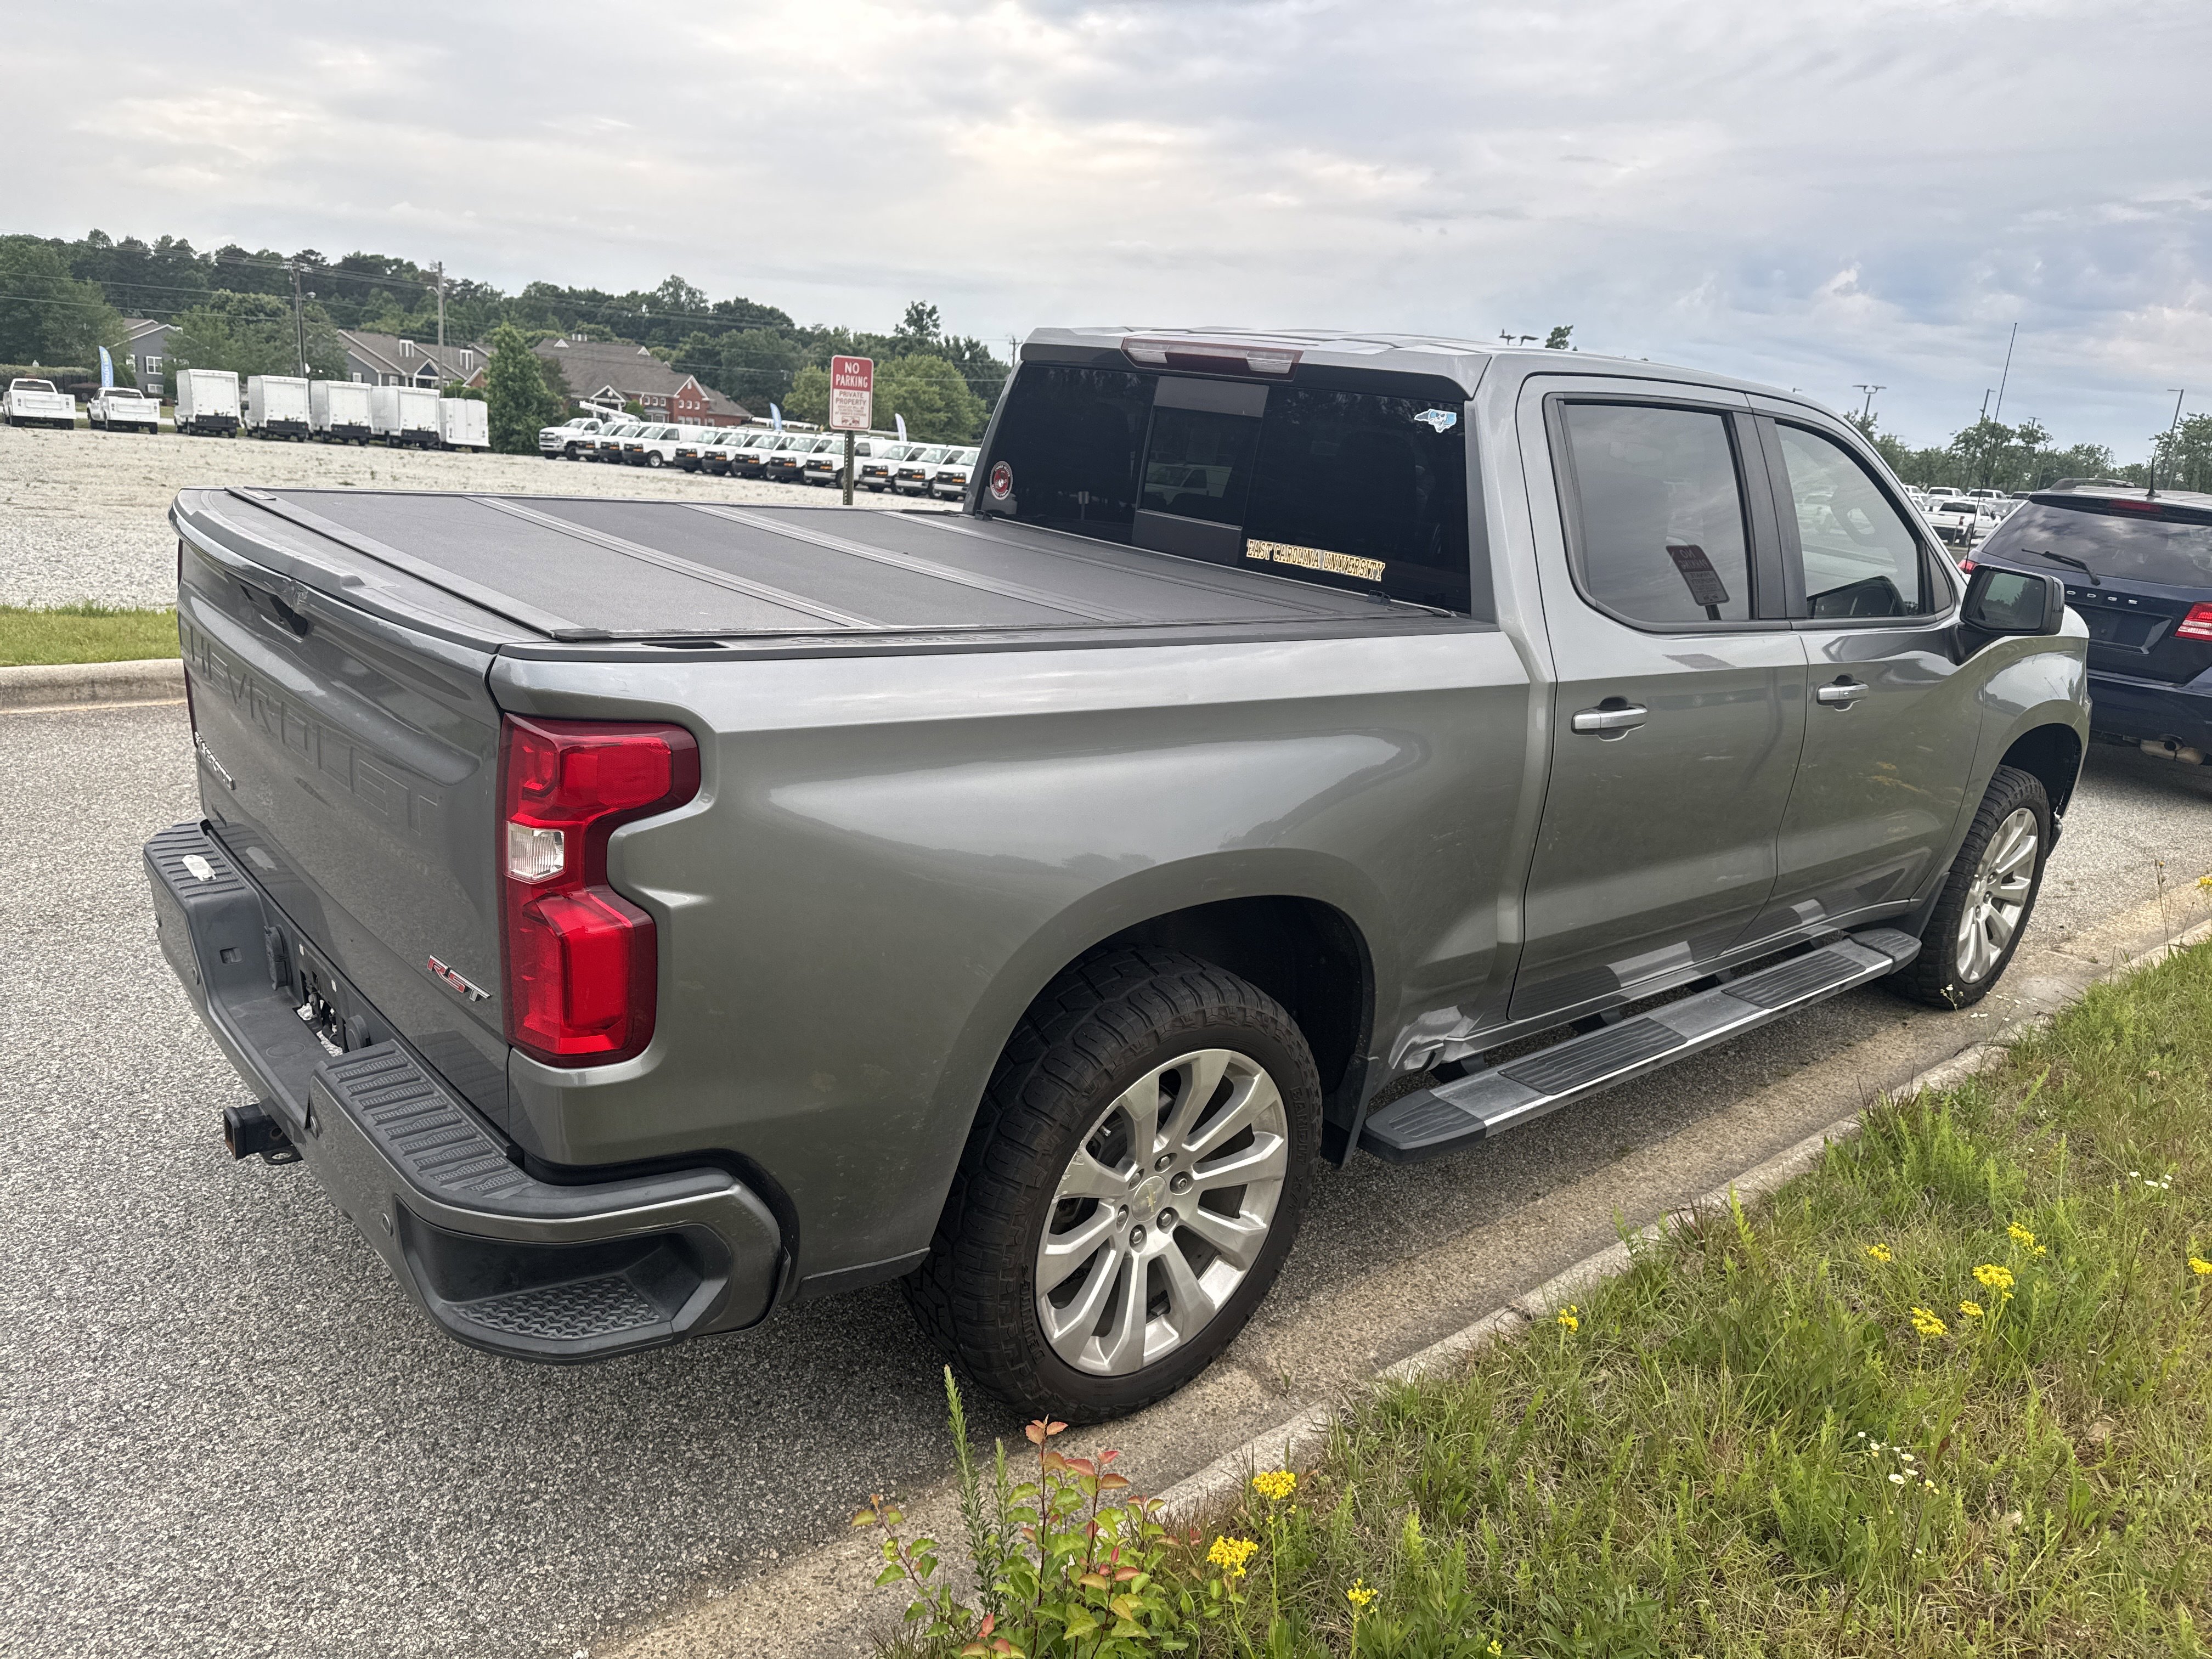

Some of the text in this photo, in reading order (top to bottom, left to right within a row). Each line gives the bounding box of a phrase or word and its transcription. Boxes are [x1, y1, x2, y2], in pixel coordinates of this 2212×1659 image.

[844, 362, 860, 374] NO
[836, 374, 868, 388] PARKING
[836, 397, 867, 405] PROPERTY
[839, 391, 864, 399] PRIVATE
[1246, 539, 1386, 582] EAST CAROLINA UNIVERSITY
[2066, 590, 2138, 605] ODGE
[178, 610, 438, 837] CHEVROLET
[427, 955, 491, 1002] RST
[1290, 1086, 1308, 1165] BANDIT
